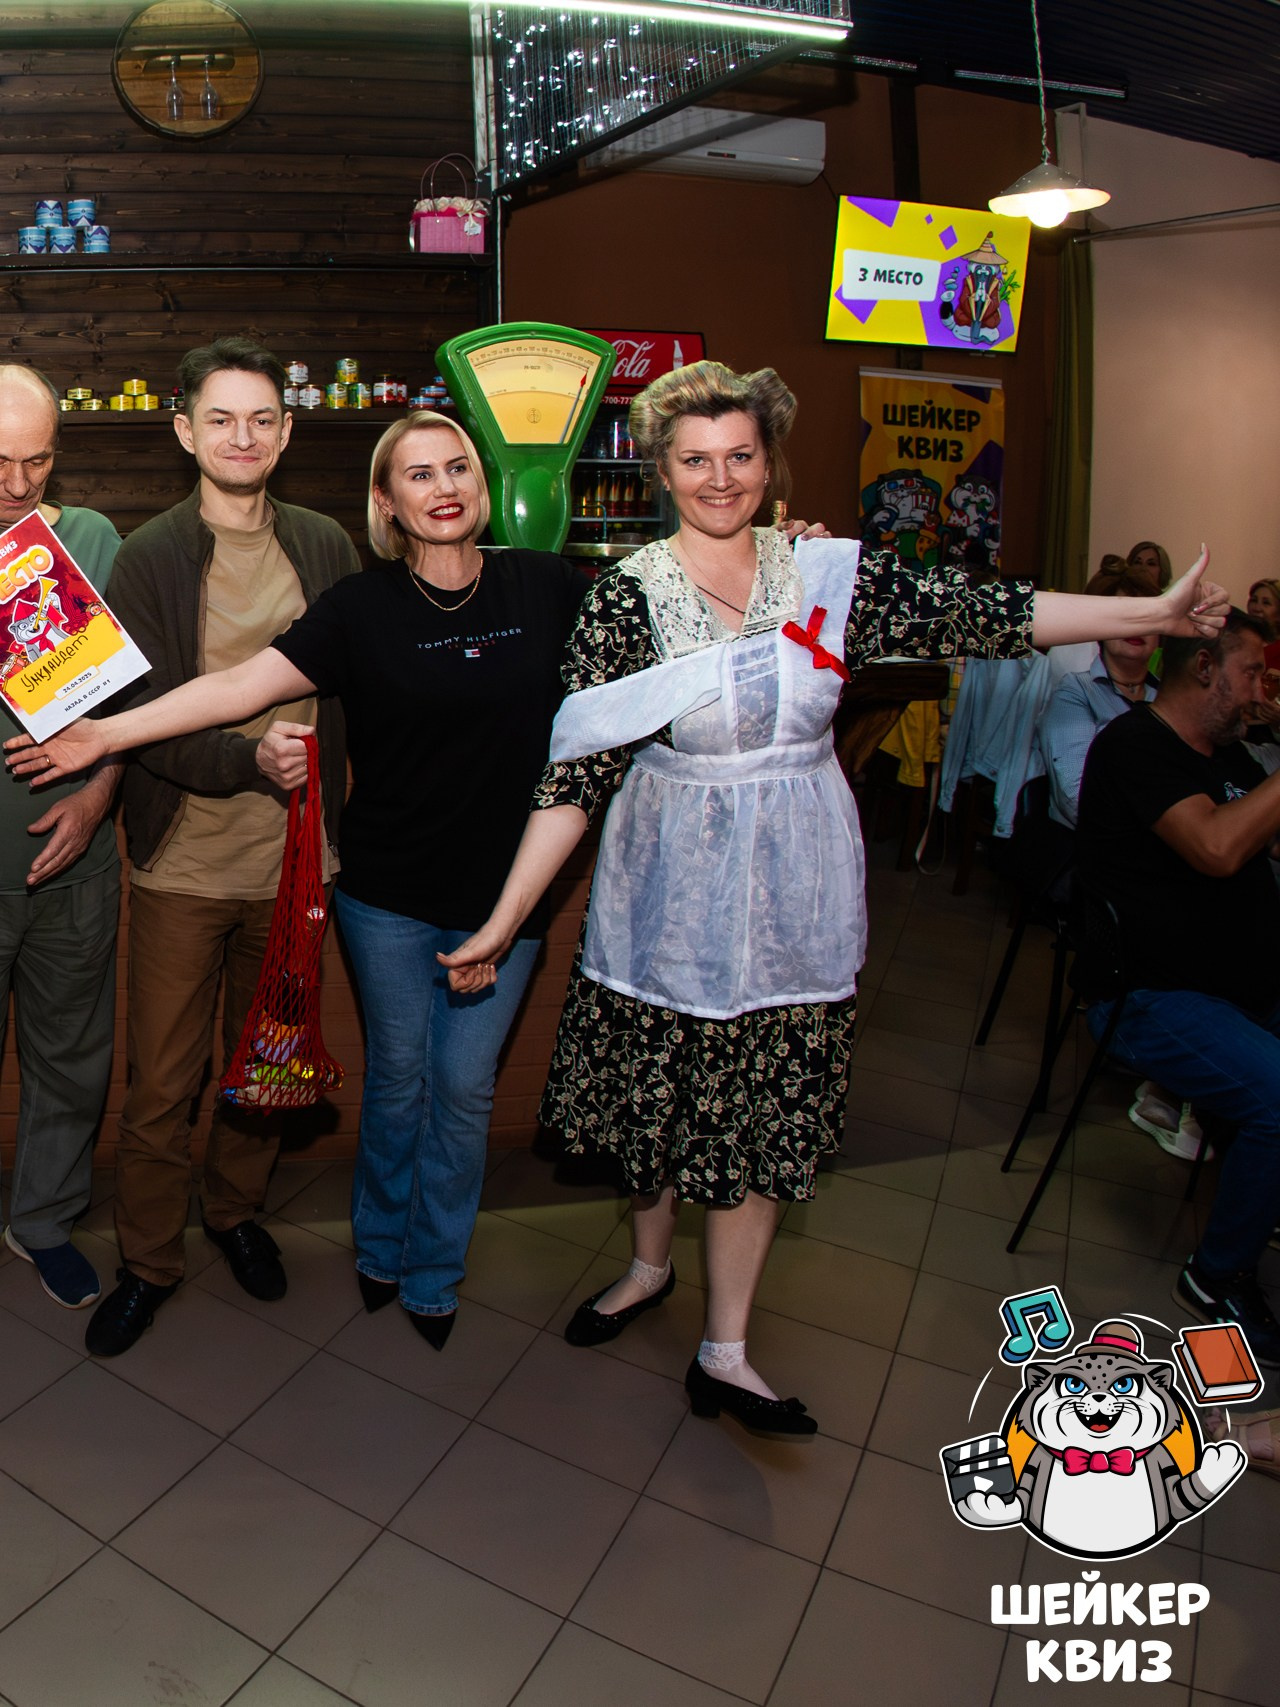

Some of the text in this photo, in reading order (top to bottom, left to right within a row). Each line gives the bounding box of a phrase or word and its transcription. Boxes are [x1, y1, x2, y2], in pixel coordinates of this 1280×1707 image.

[858, 267, 924, 286] 3 МЕСТО
[882, 400, 981, 433] ШЕЙКЕР
[897, 435, 964, 463] КВИЗ
[417, 636, 460, 649] TOMMY
[466, 628, 522, 643] HILFIGER
[64, 698, 83, 712] НАЗАД
[88, 685, 101, 696] СССР
